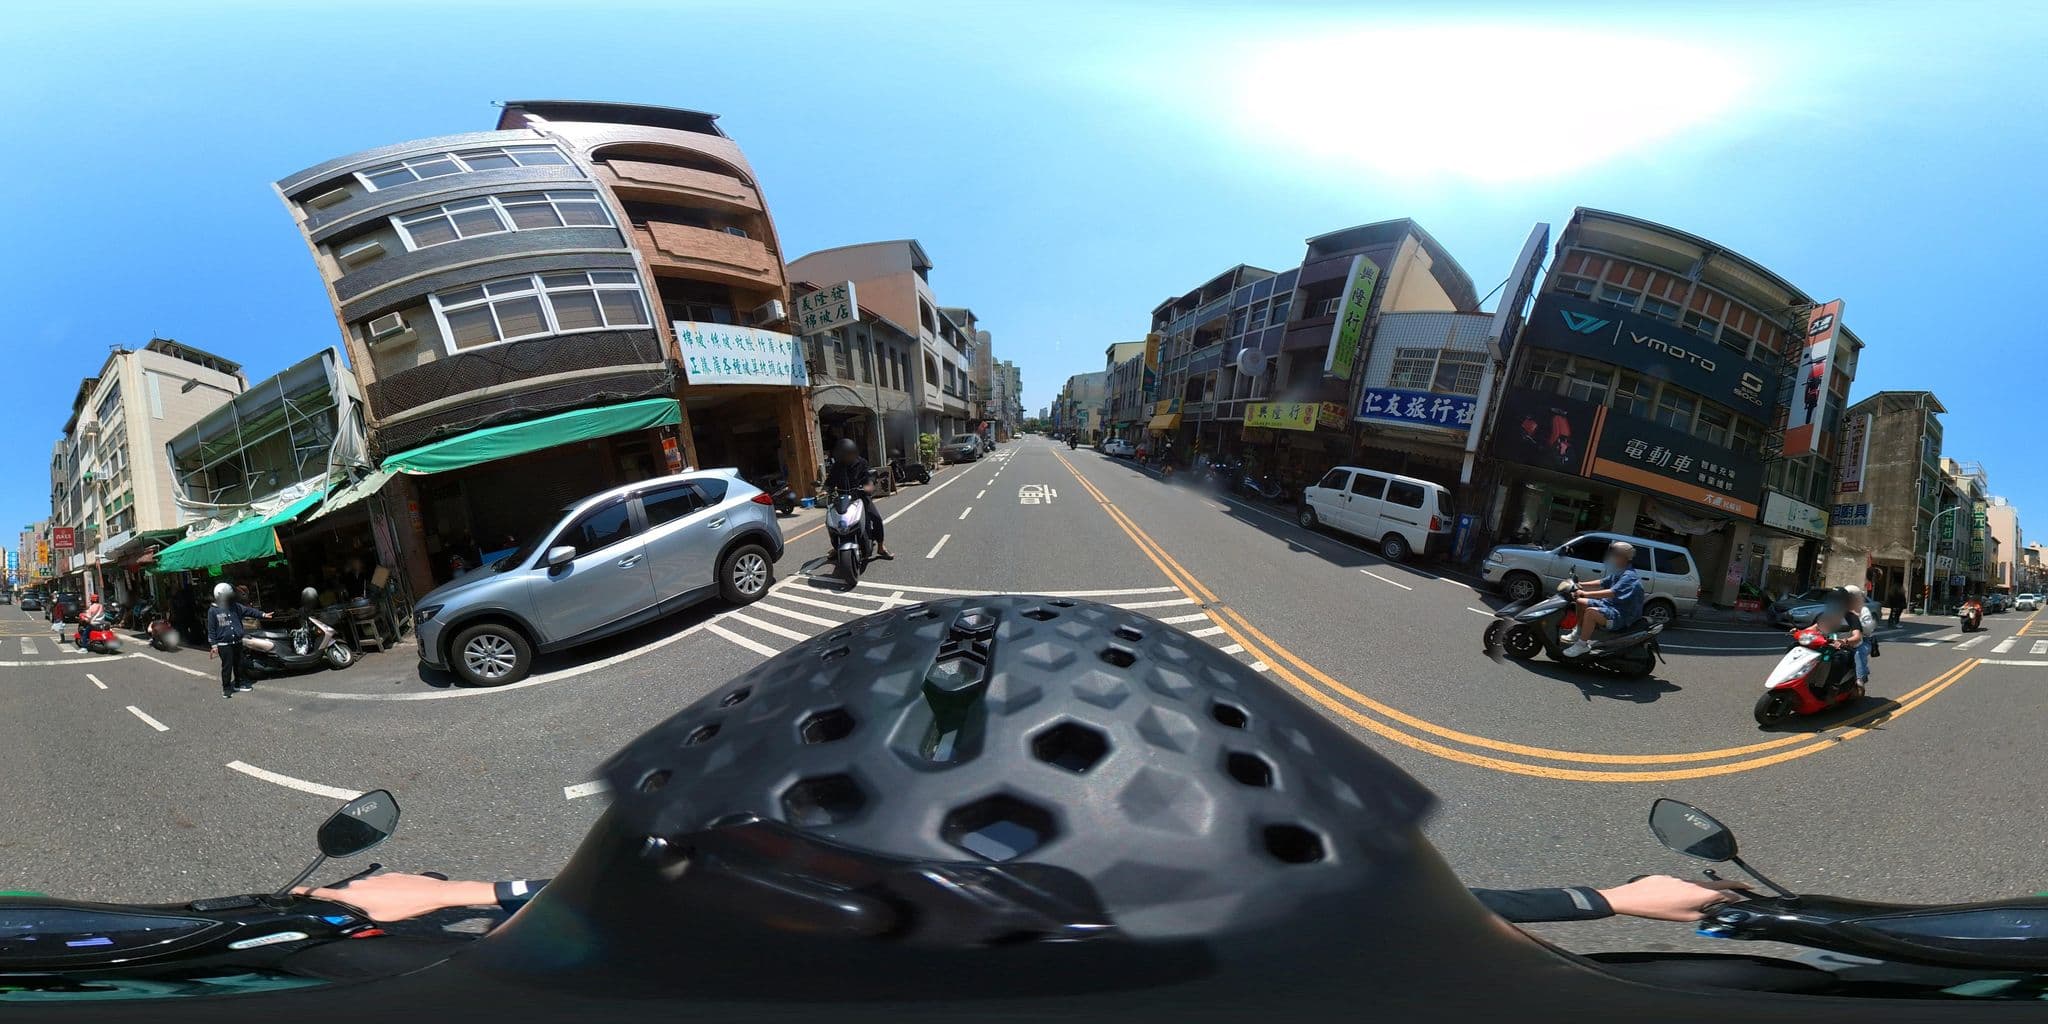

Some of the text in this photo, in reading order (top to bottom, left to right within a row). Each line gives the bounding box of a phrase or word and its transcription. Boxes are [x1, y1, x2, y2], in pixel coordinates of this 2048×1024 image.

[804, 303, 849, 329] 棉被店
[1630, 331, 1716, 373] VMOTO
[1365, 392, 1477, 425] 仁友旅行社
[1624, 438, 1695, 473] 電動車
